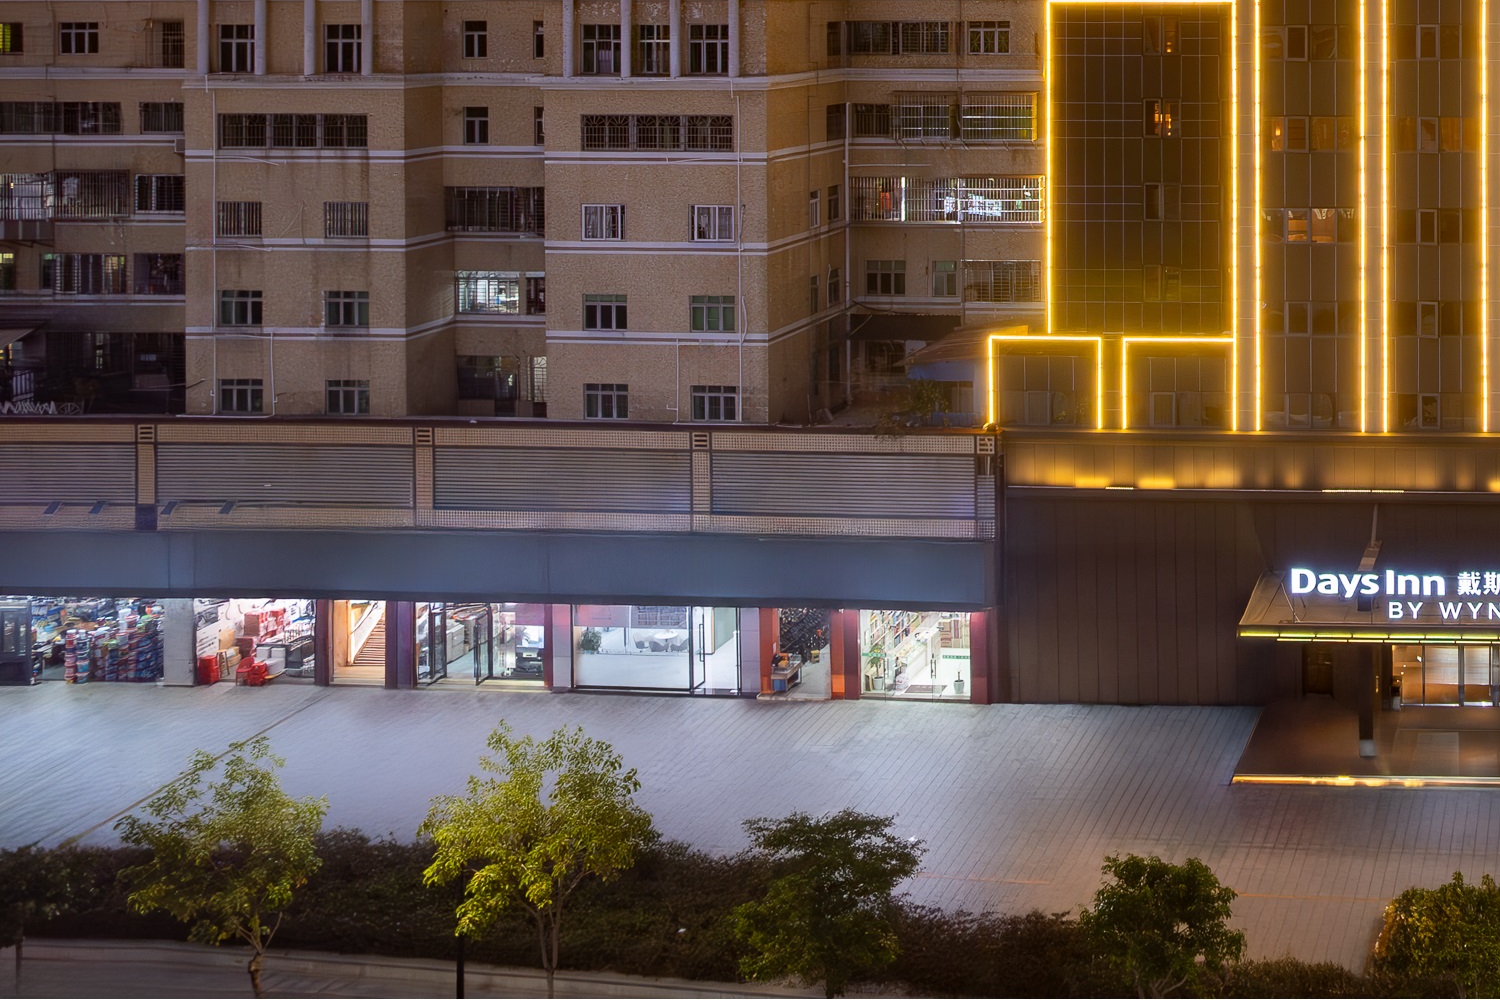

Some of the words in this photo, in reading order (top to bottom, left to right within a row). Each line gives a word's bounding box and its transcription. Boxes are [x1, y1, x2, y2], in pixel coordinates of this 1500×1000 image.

[1290, 568, 1380, 598] Days
[1385, 569, 1446, 596] Inn
[1388, 601, 1424, 619] BY
